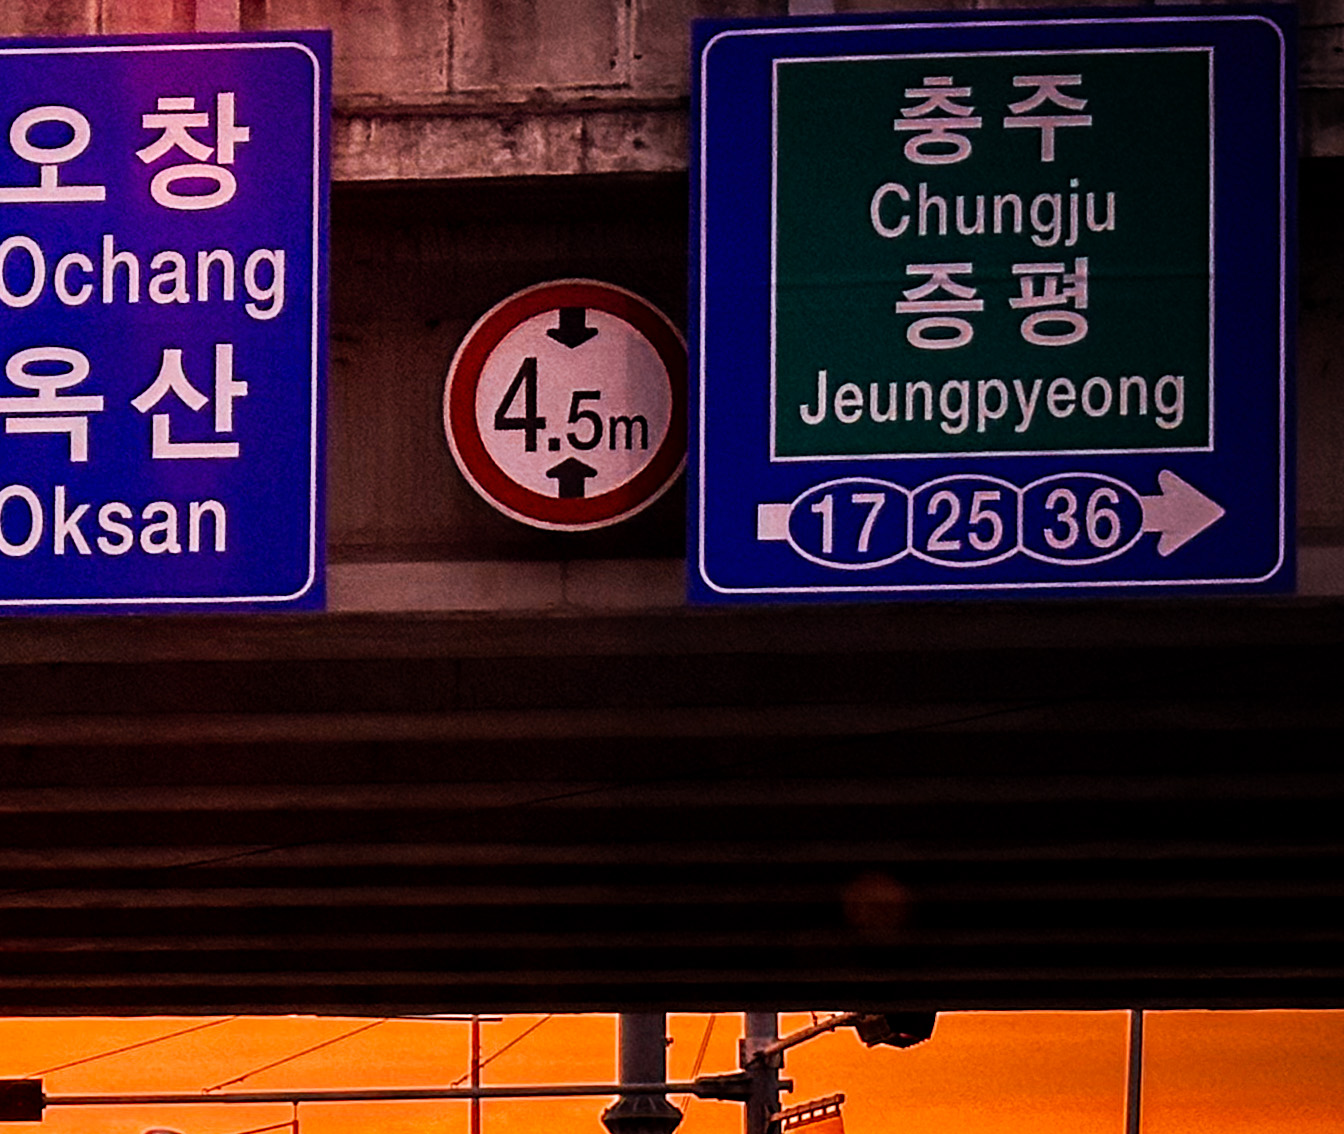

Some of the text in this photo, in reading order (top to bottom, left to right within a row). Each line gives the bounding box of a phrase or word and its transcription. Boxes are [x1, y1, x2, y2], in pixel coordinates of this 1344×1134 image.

[892, 73, 1094, 166] 충주
[869, 177, 1118, 247] Chungju
[894, 255, 1093, 351] 증평
[492, 355, 651, 454] 4.5m
[798, 369, 1187, 436] Jeungpyeong
[809, 486, 1123, 554] 17 25 36
